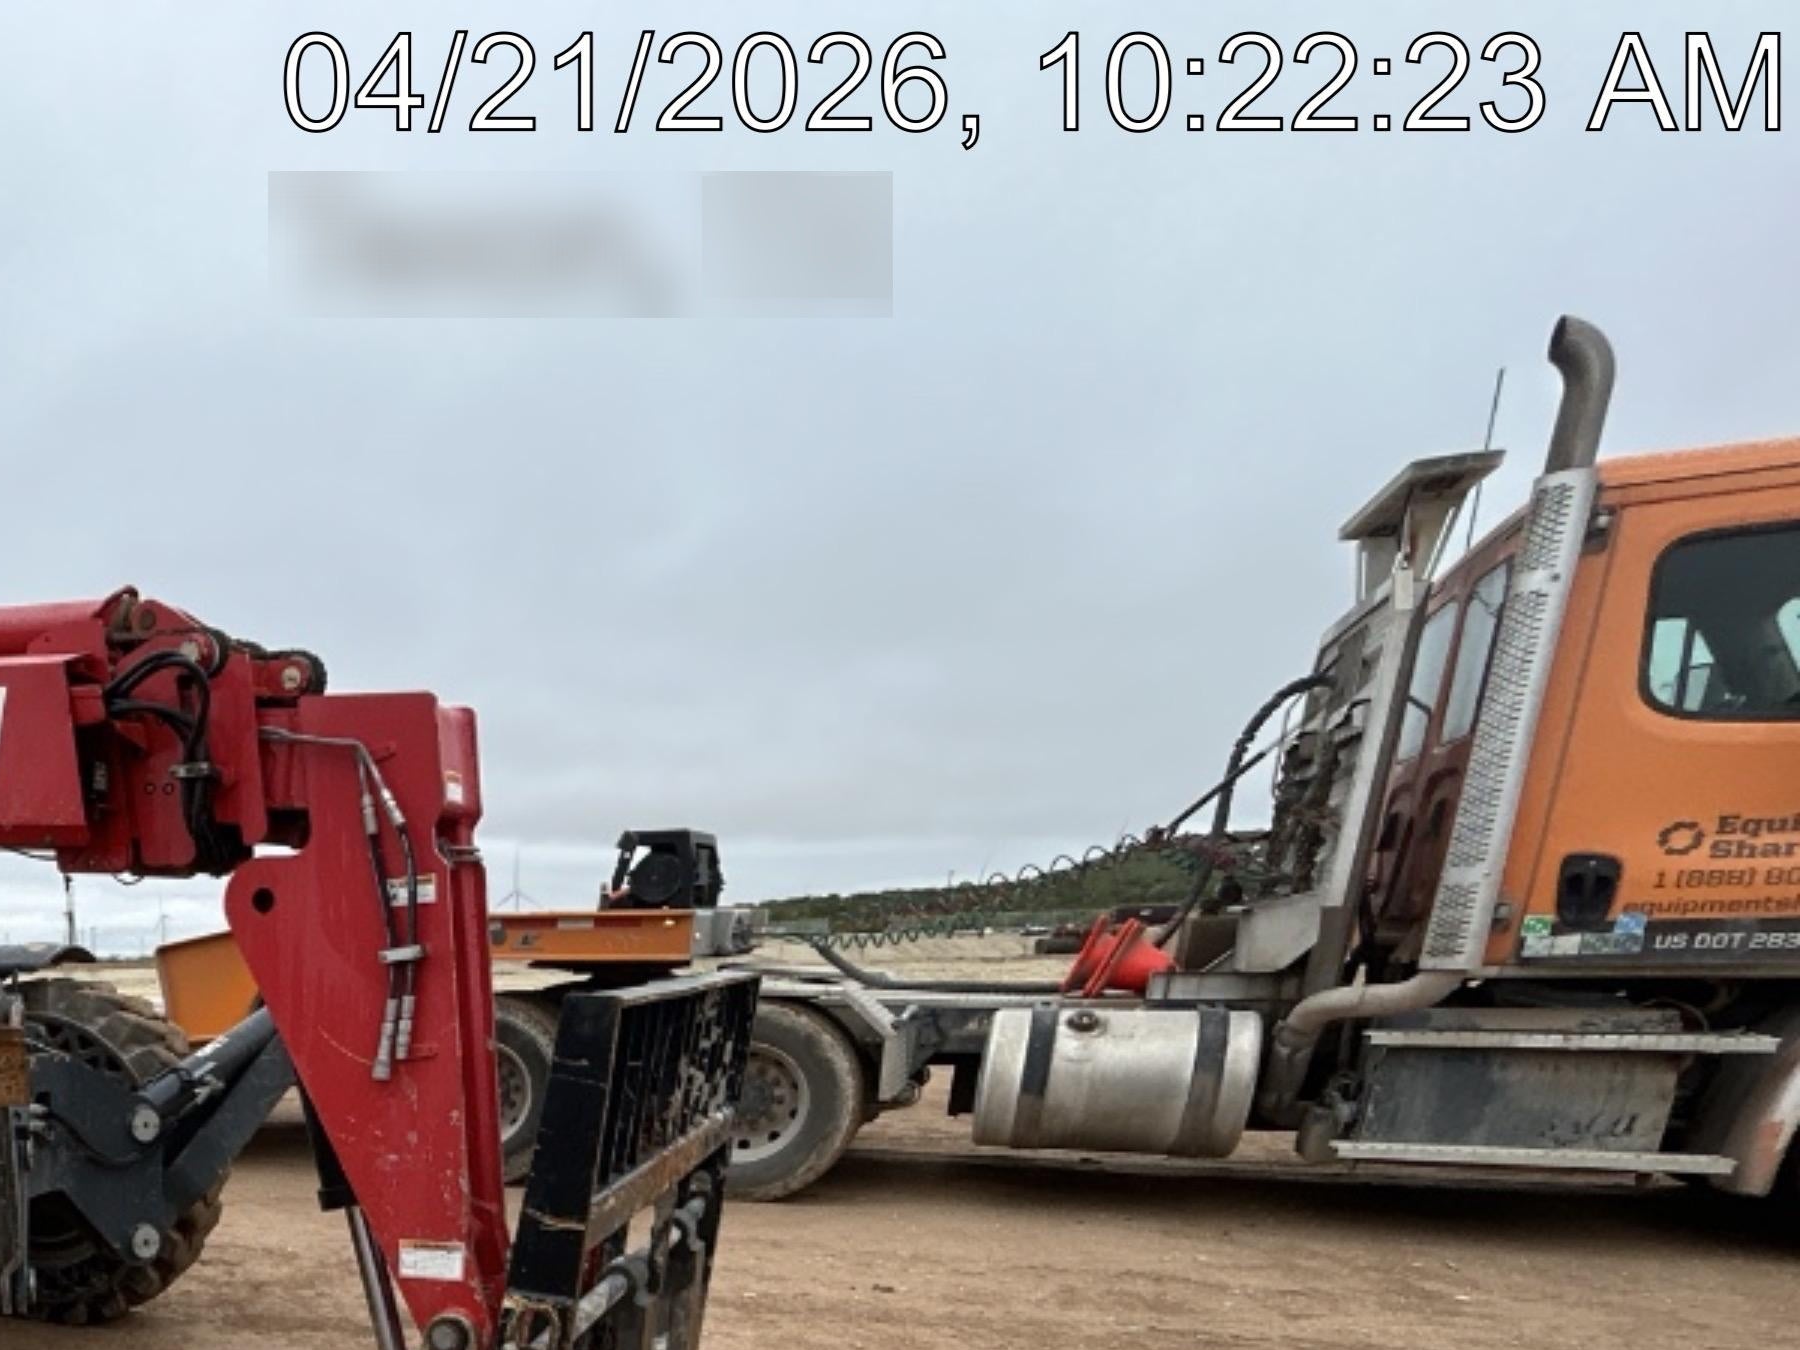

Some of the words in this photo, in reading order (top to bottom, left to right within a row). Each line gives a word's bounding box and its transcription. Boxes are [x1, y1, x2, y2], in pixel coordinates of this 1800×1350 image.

[1653, 871, 1666, 888] 1
[1675, 867, 1756, 888] (888)
[1654, 932, 1688, 949] US
[1694, 932, 1745, 949] DOT
